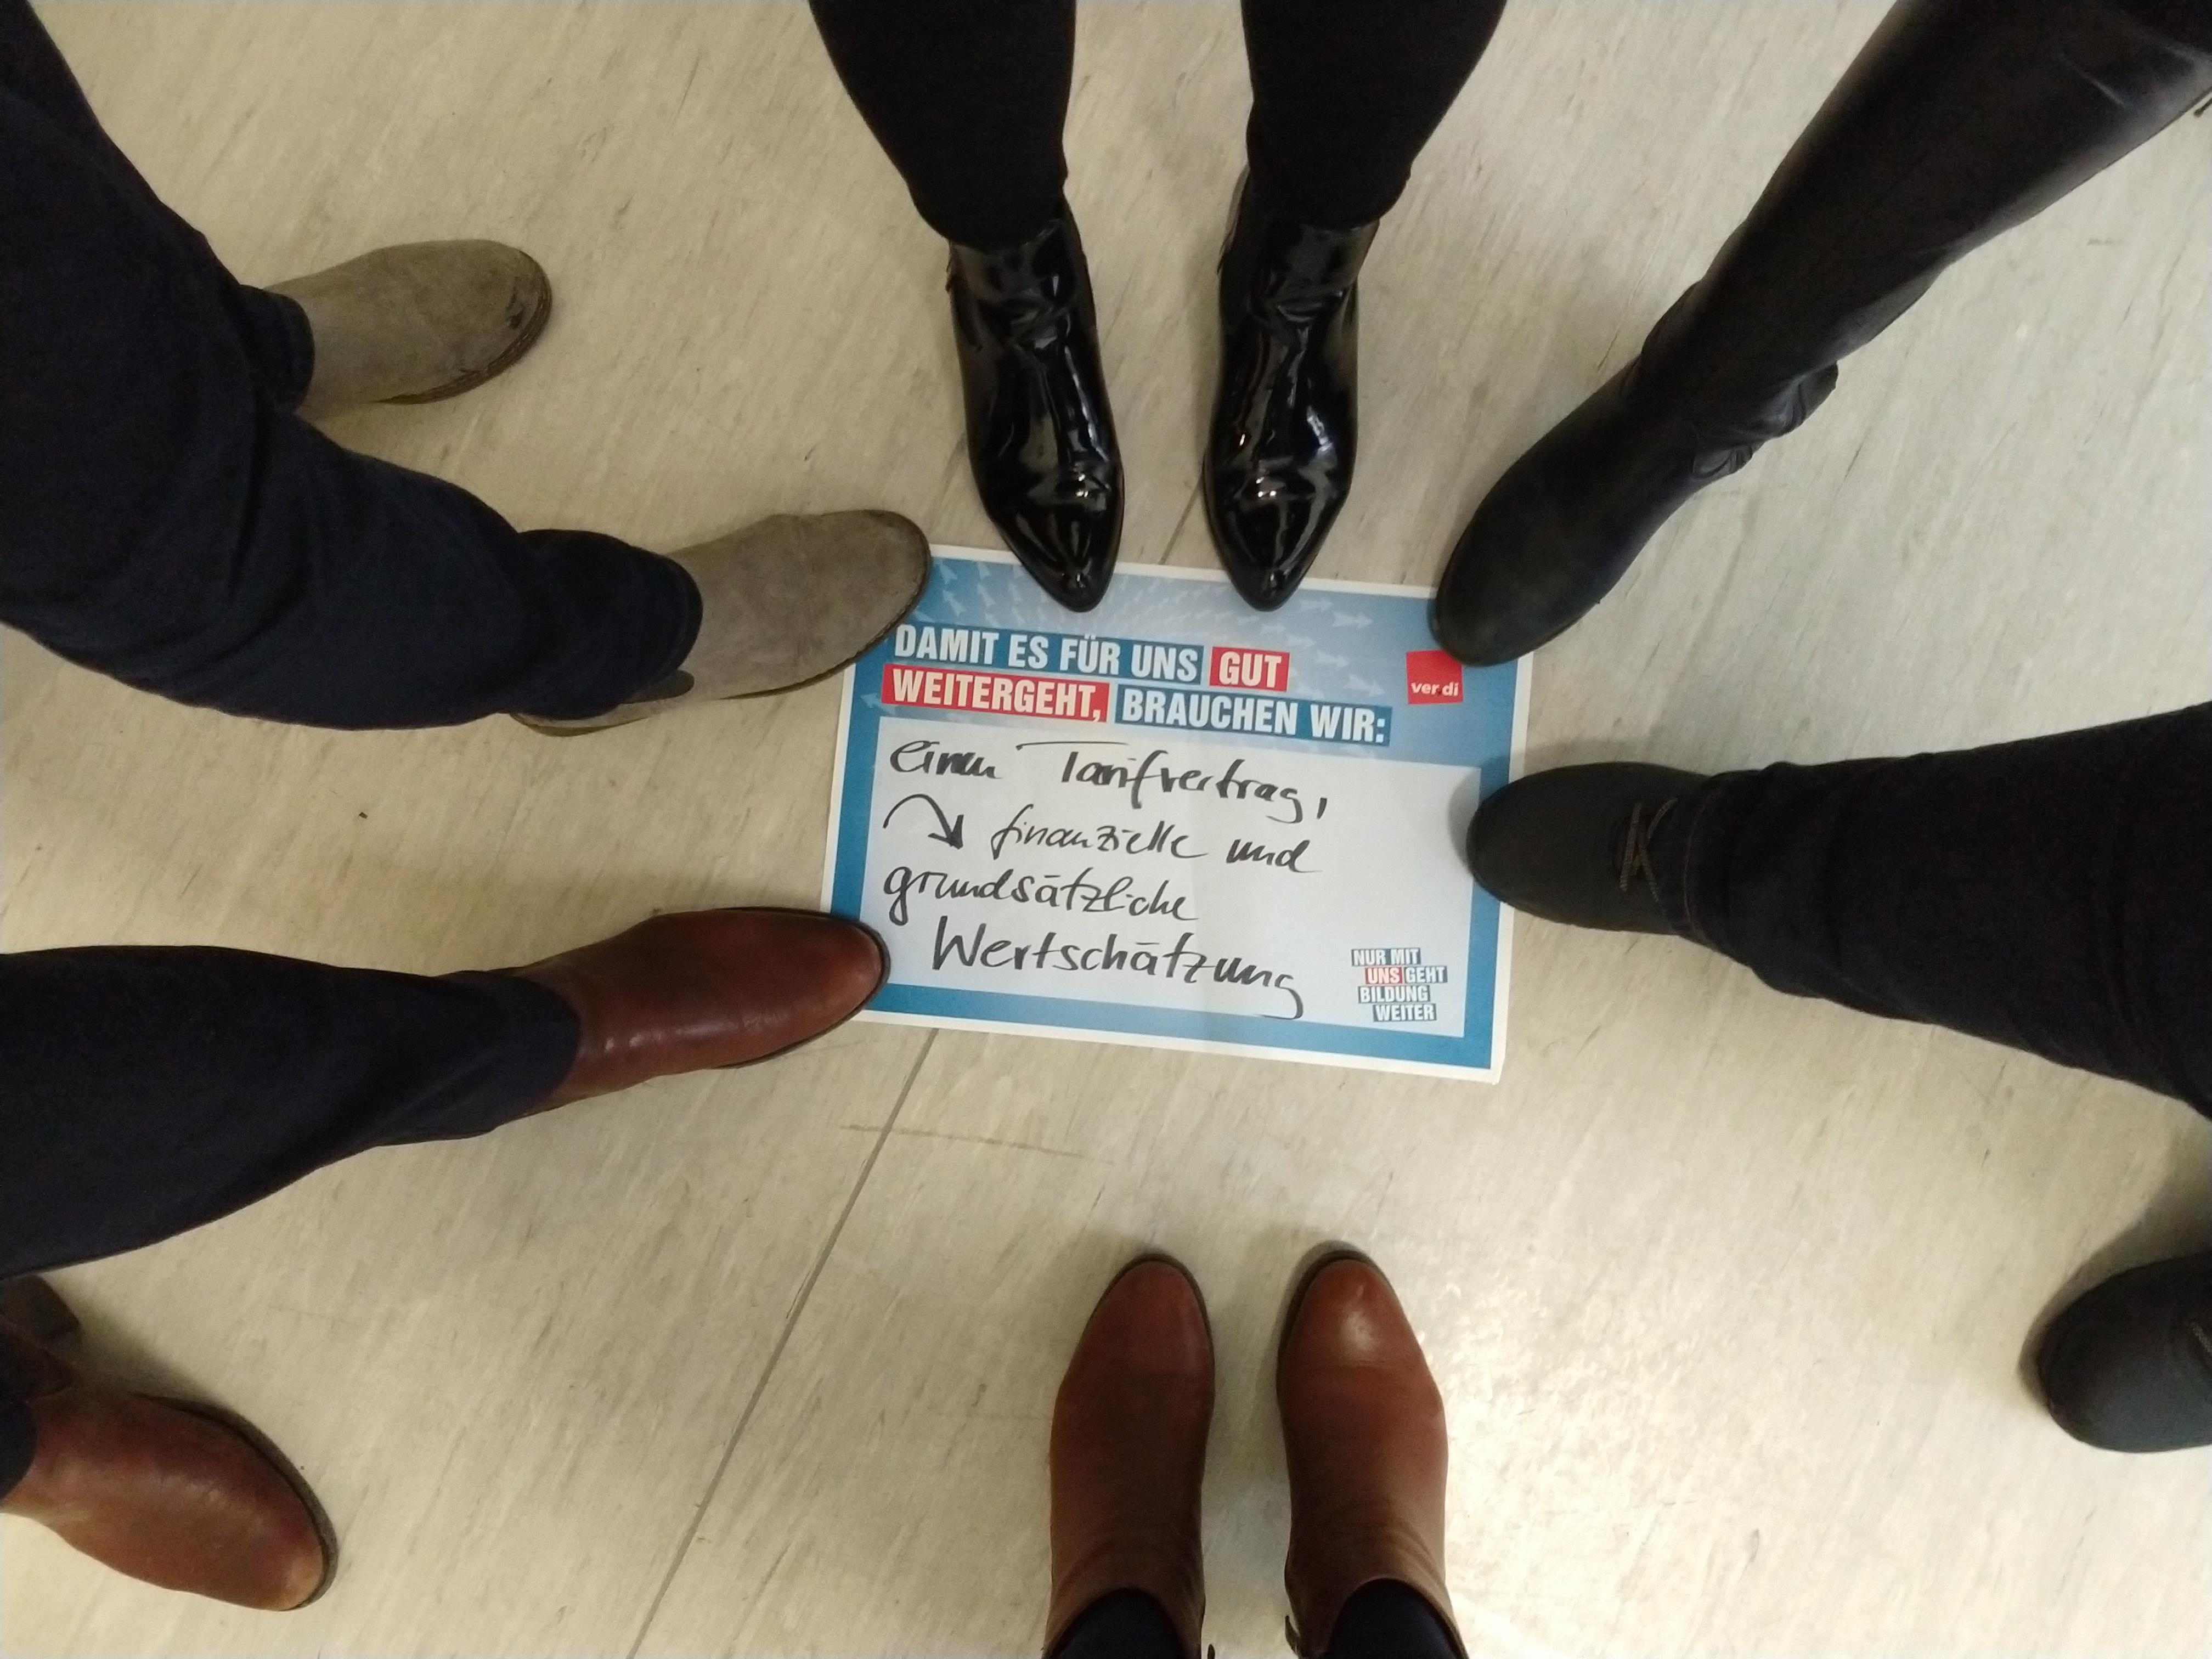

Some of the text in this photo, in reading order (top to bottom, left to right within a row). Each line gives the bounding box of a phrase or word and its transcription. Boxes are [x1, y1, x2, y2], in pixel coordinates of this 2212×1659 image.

[894, 624, 1282, 689] DAMIT ES FÜR UNS GUT
[892, 668, 1386, 743] WEITERGEHT, BRAUCHEN WIR:
[990, 804, 1324, 874] finanzielle und
[883, 866, 1199, 926] grundsätzliche
[931, 915, 1304, 1020] Wertschätzung
[1353, 948, 1419, 966] NUR MIT
[1367, 967, 1446, 984] UNS GEHT
[1359, 985, 1429, 1003] BILDUNG
[1375, 1004, 1435, 1021] WEITER
